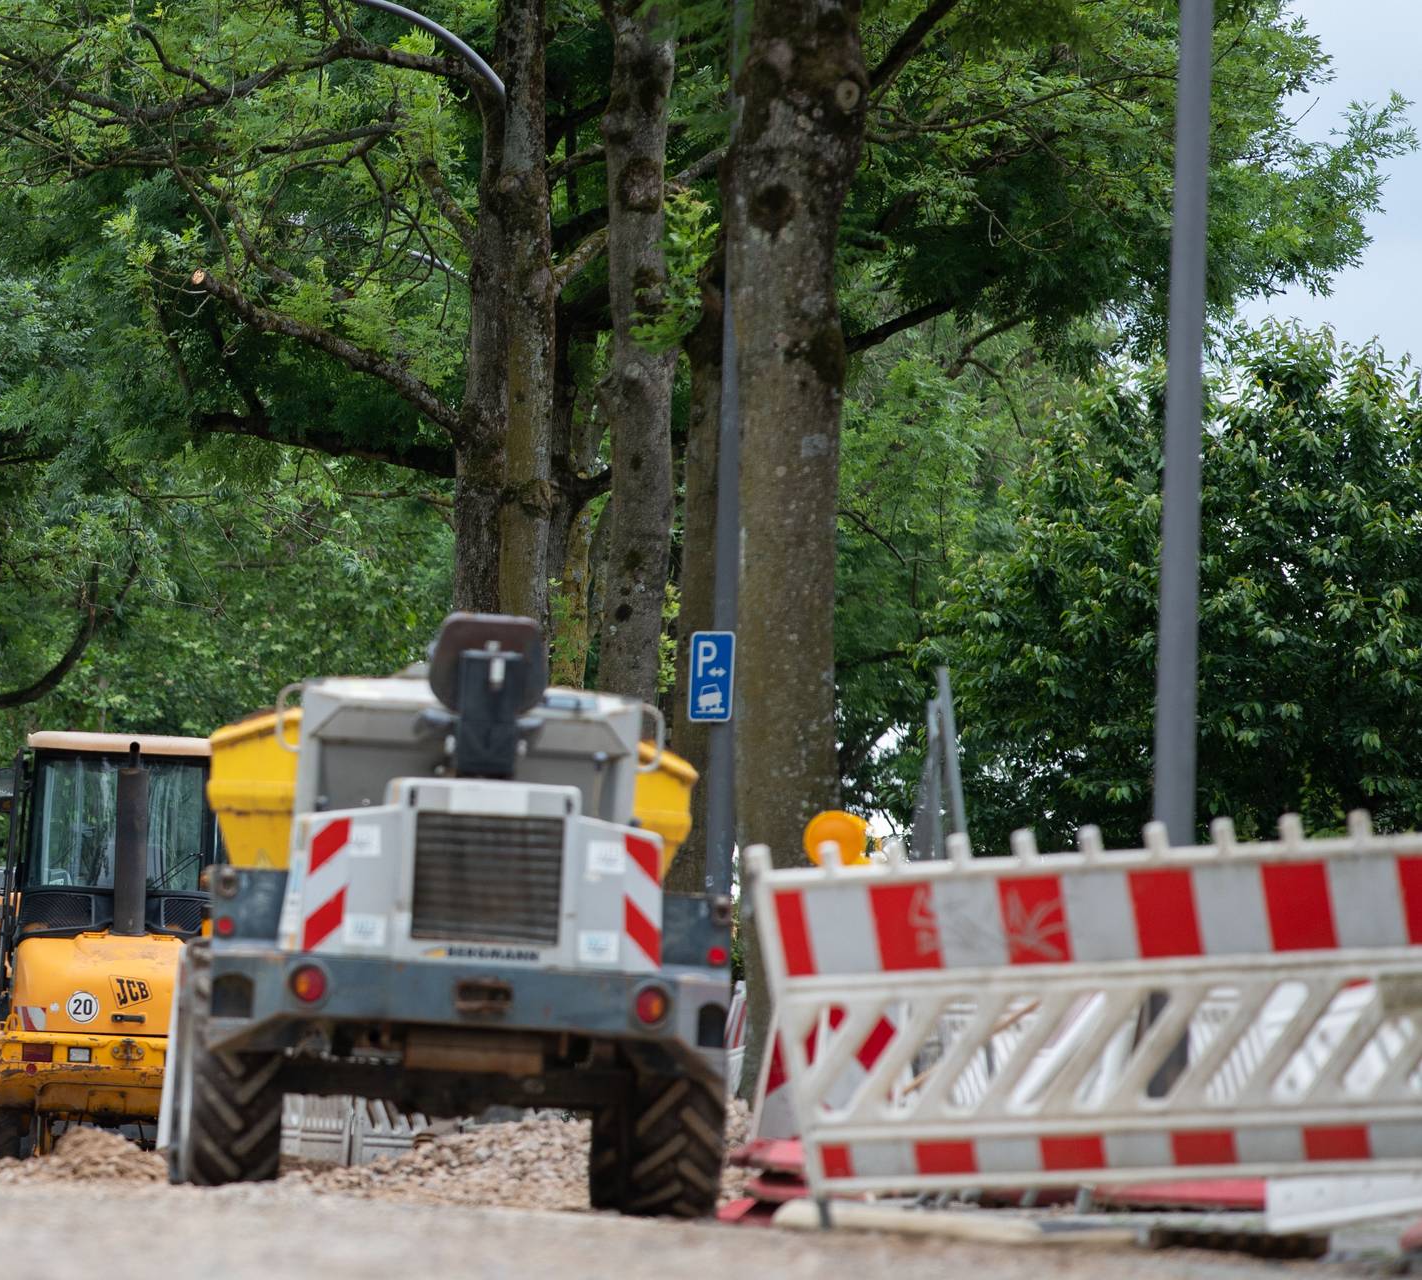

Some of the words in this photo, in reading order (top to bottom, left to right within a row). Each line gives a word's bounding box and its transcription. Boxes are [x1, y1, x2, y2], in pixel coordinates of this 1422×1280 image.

[697, 641, 717, 678] P
[116, 978, 149, 1006] JCB
[73, 998, 93, 1016] 20
